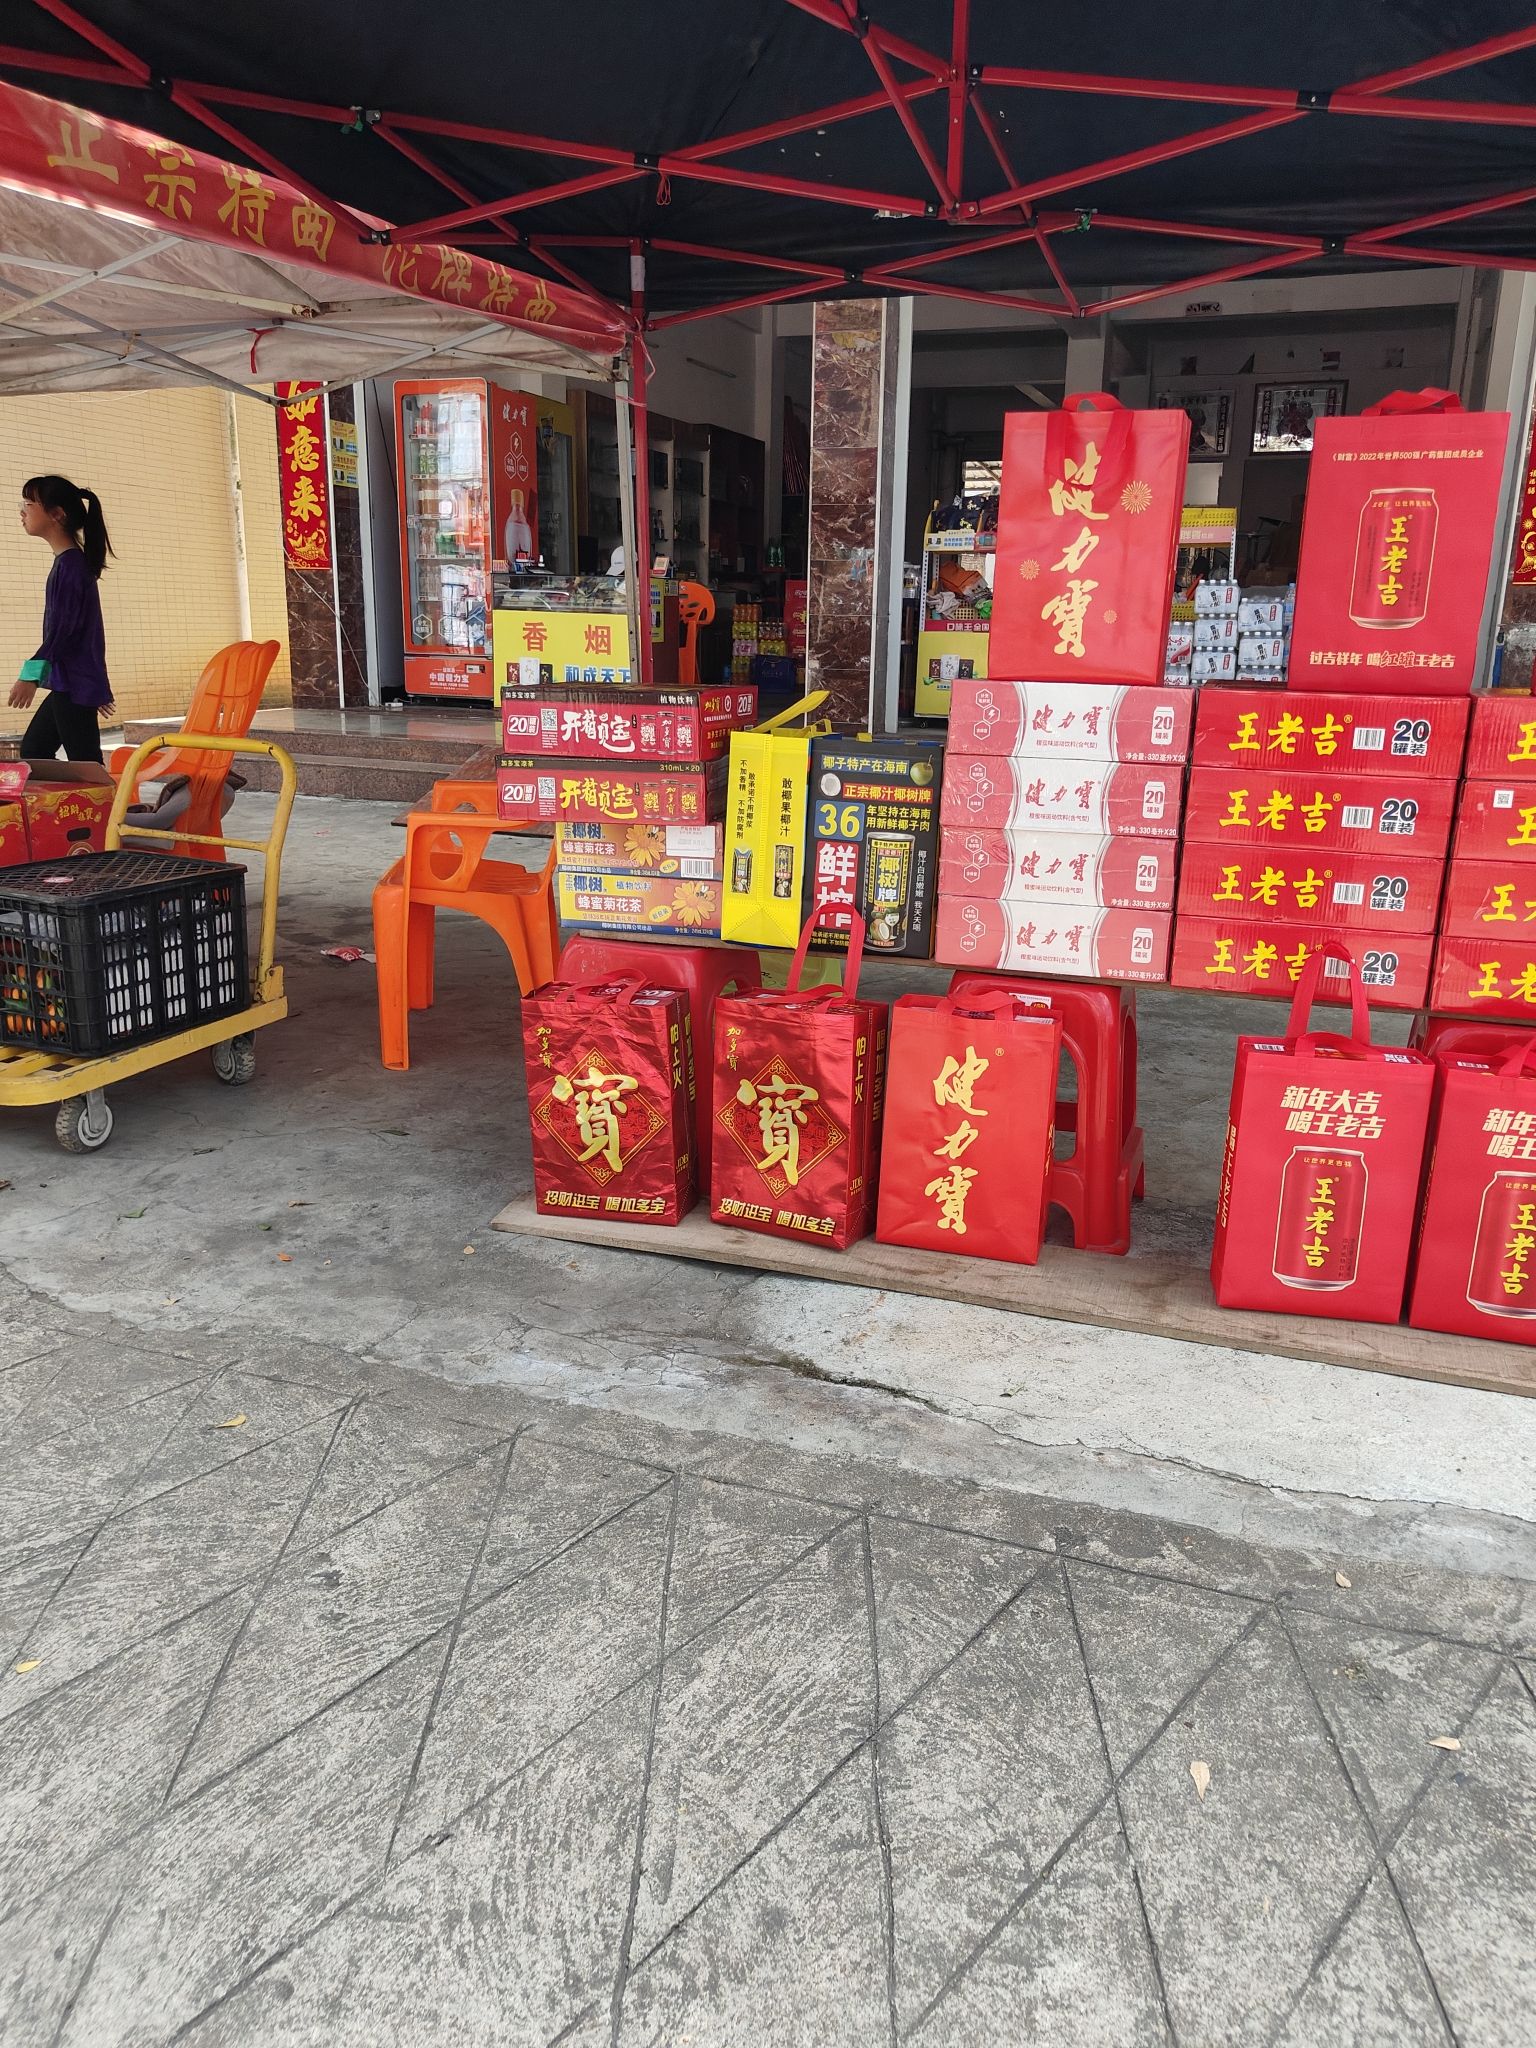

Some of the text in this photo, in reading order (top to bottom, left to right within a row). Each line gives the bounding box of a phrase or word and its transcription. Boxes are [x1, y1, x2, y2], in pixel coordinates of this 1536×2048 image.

[1377, 516, 1410, 606] 王老吉
[522, 621, 612, 656] 香烟
[1309, 651, 1455, 668] 过吉祥年 喝红罐王老吉
[505, 691, 694, 705] 加多宝凉茶 植物饮料
[738, 696, 748, 713] 20
[508, 717, 528, 733] 20
[1153, 715, 1173, 730] 20
[1229, 712, 1430, 756] 王老吉 20
[1391, 742, 1426, 756] 罐装
[501, 759, 534, 768] 加多宝凉茶
[823, 755, 908, 774] 椰子特产在海南
[504, 785, 524, 800] 20
[845, 785, 932, 802] 正宗椰汁椰树牌
[1145, 790, 1164, 804] 20
[866, 805, 932, 820] 年坚持在海南
[1219, 789, 1418, 833] 王老吉 20
[818, 803, 860, 838] 36
[866, 816, 931, 832] 用新鲜椰子肉
[1380, 821, 1414, 834] 罐装
[563, 841, 616, 855] 蜂蜜菊花茶
[877, 857, 900, 902] 椰树牌
[1138, 864, 1157, 878] 20
[1212, 865, 1408, 908] 王老吉 20
[577, 895, 642, 913] 蜂蜜菊花茶
[1371, 899, 1405, 911] 罐装
[912, 901, 923, 931] 我天天喝
[1133, 936, 1152, 950] 20
[1205, 938, 1398, 981] 王老吉 20
[1361, 973, 1395, 986] 罐装
[670, 1023, 682, 1089] 怕上火
[855, 1036, 867, 1105] 怕上火
[1280, 1085, 1383, 1115] 新年大吉
[1285, 1111, 1387, 1139] 喝王老吉
[1303, 1156, 1353, 1168] 让世界更吉祥
[850, 1176, 863, 1191] JDB
[605, 1196, 666, 1216] 喝加多宝
[776, 1212, 836, 1237] 喝加多宝
[1302, 1177, 1336, 1268] 王老吉
[1500, 1203, 1536, 1295] 王老吉
